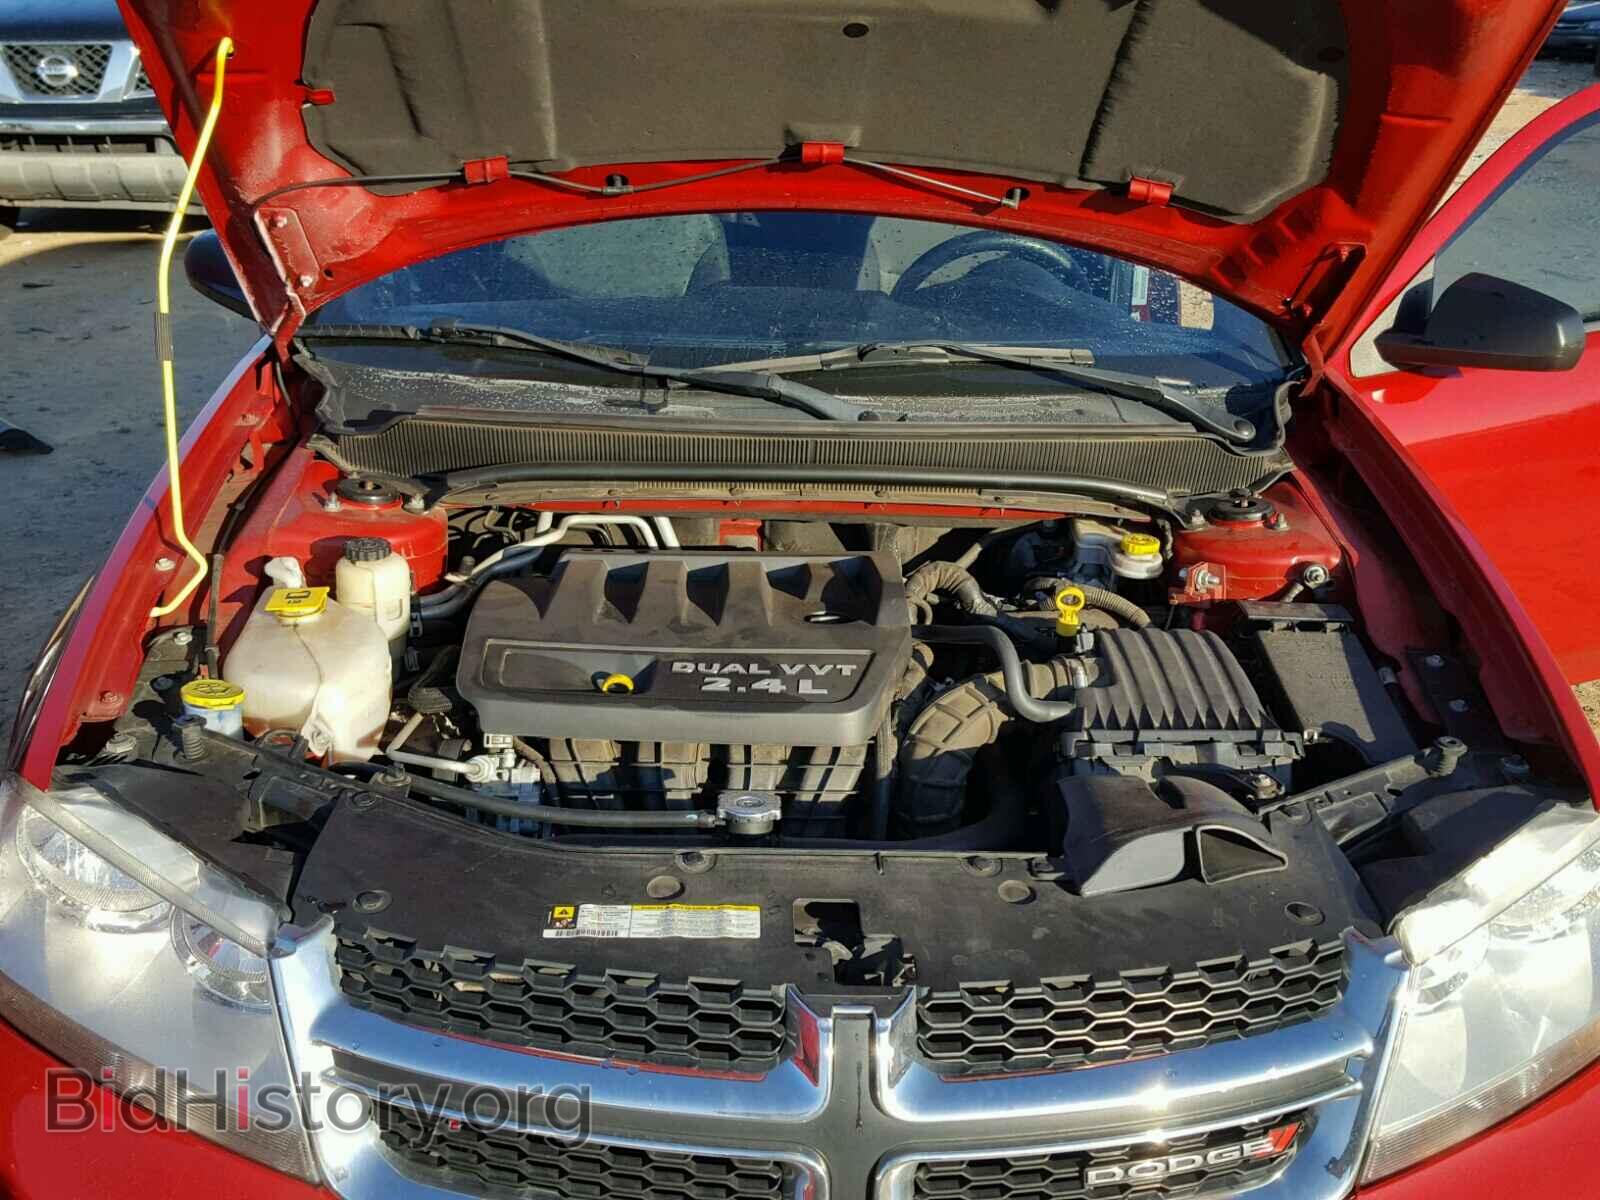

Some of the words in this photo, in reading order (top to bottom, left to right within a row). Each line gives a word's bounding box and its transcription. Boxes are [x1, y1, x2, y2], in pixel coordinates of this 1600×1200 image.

[671, 661, 771, 674] DUAL
[778, 663, 857, 676] VVT
[1087, 1136, 1274, 1185] DODGE
